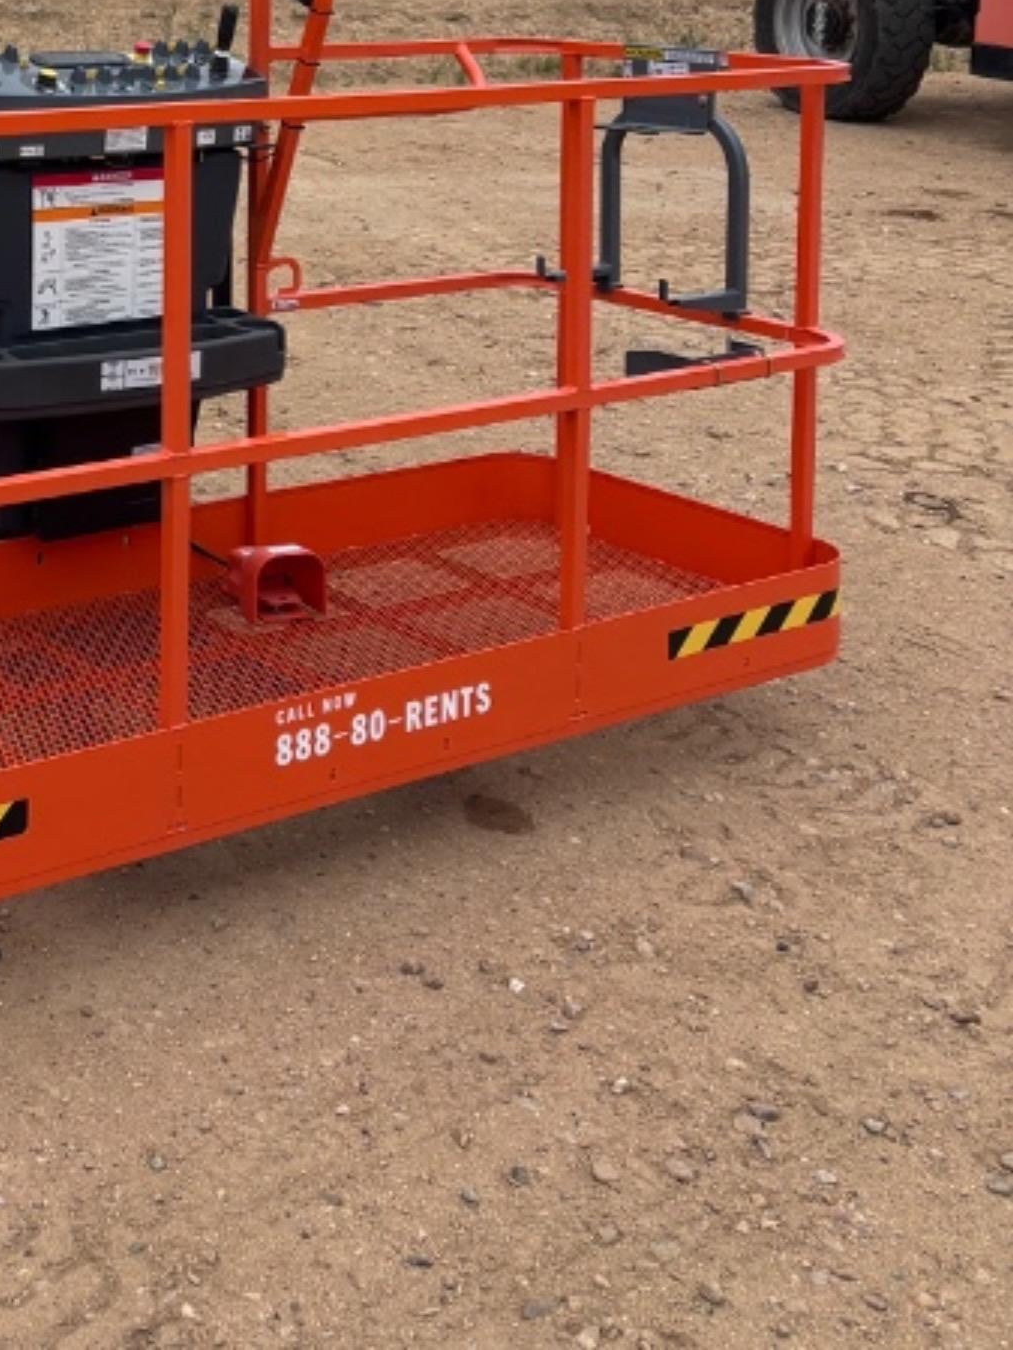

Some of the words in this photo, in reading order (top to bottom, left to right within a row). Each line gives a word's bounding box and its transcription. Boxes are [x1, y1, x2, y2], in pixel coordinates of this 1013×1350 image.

[275, 704, 315, 725] CALL
[322, 692, 357, 714] NOW
[275, 682, 493, 767] 888-80-RENTS
